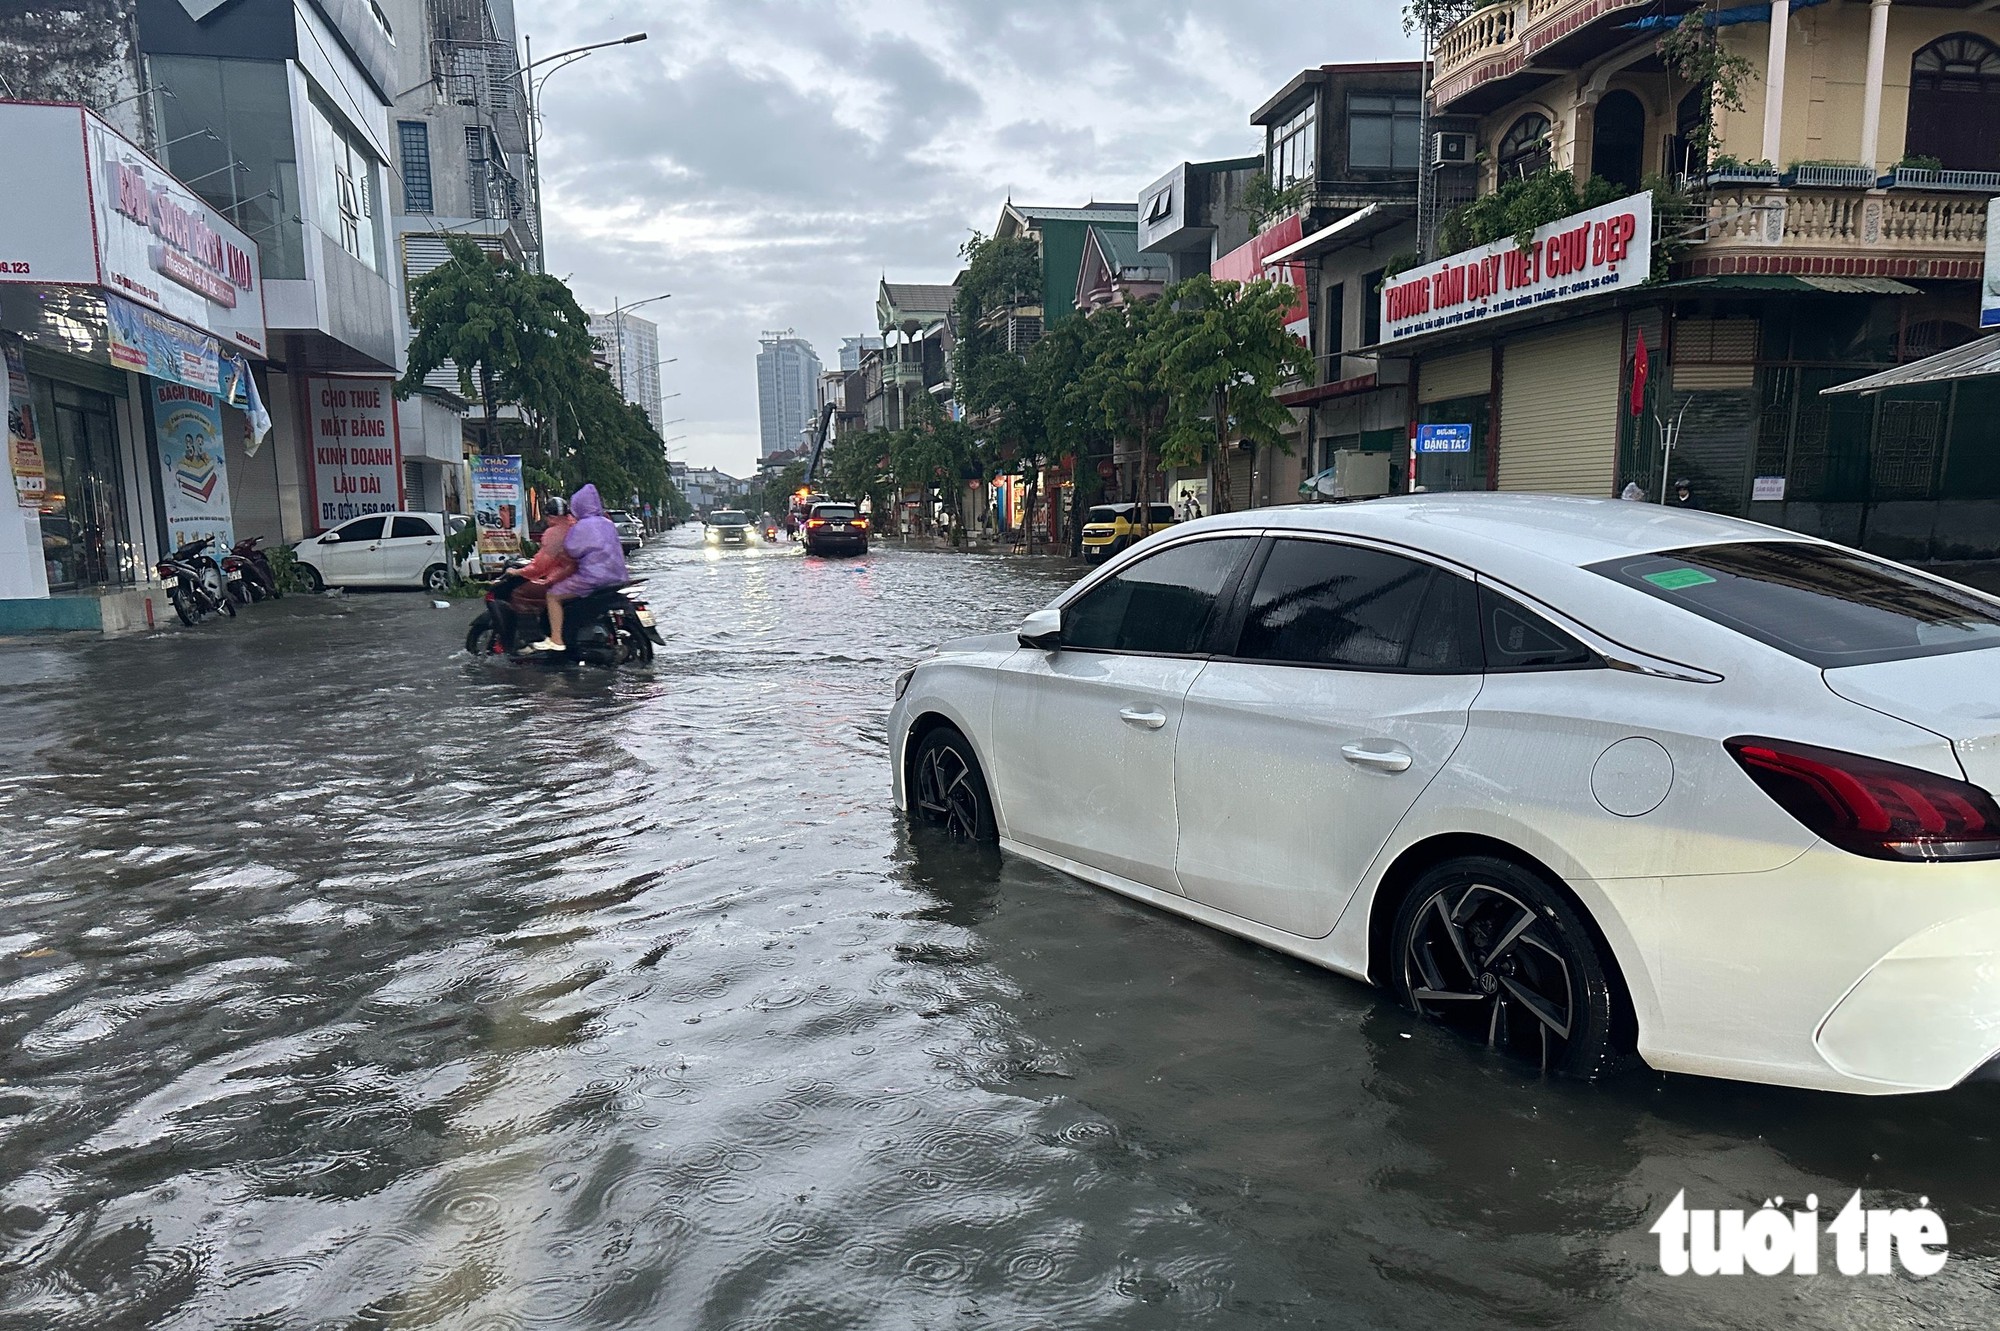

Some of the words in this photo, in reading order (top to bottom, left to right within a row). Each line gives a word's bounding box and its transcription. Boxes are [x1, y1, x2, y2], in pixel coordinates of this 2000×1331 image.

[0, 261, 30, 274] 9.123
[226, 241, 253, 291] KHOA
[1385, 276, 1430, 323] TRUNG
[1432, 263, 1465, 310] TÂM
[1467, 254, 1502, 304] DẠY
[1592, 213, 1636, 272] ĐẸP
[158, 383, 185, 402] BÁCH
[187, 386, 213, 408] KHOA
[321, 389, 346, 408] CHO
[349, 388, 381, 408] THUÊ
[321, 415, 347, 440] MẶT
[351, 413, 385, 437] BẰNG
[1424, 438, 1449, 451] ĐẶNG
[317, 447, 347, 465] KINH
[351, 447, 393, 466] DOANH
[484, 457, 508, 466] CHÀO
[333, 472, 357, 494] LÂU
[360, 472, 381, 494] DÀI
[323, 503, 336, 521] ĐT:
